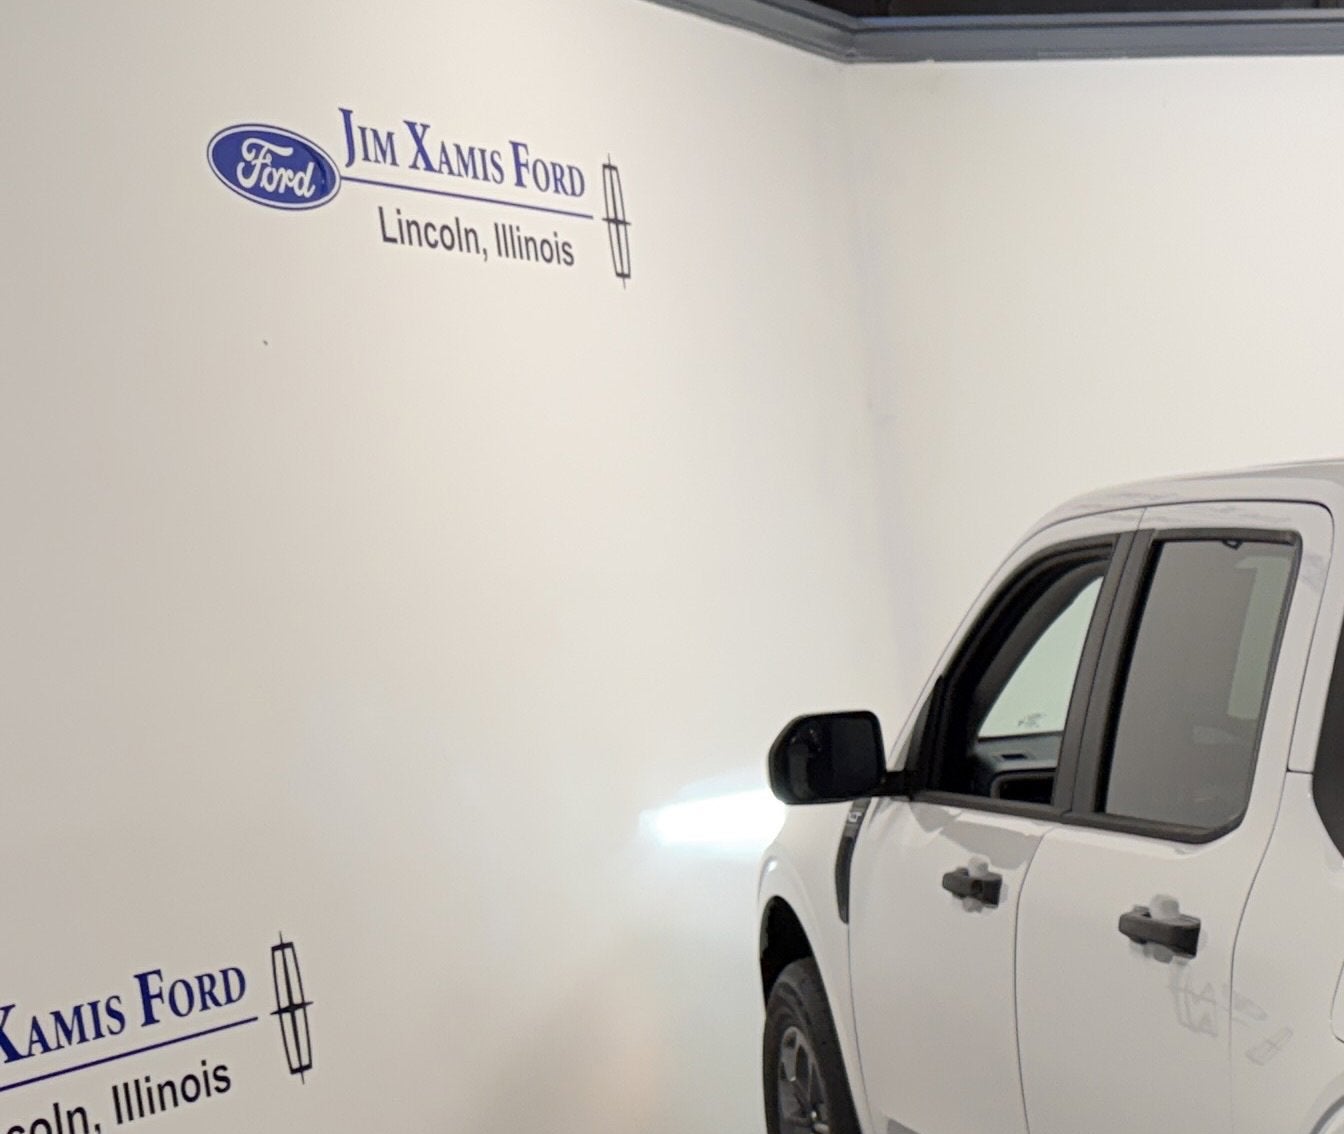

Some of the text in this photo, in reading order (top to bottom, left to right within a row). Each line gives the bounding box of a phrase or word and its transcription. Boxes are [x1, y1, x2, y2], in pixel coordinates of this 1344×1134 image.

[236, 137, 317, 199] Ford
[508, 140, 586, 198] FORD
[378, 206, 575, 267] Lincoln, Illinois
[133, 966, 247, 1027] FORD
[112, 1060, 232, 1125] Illinois
